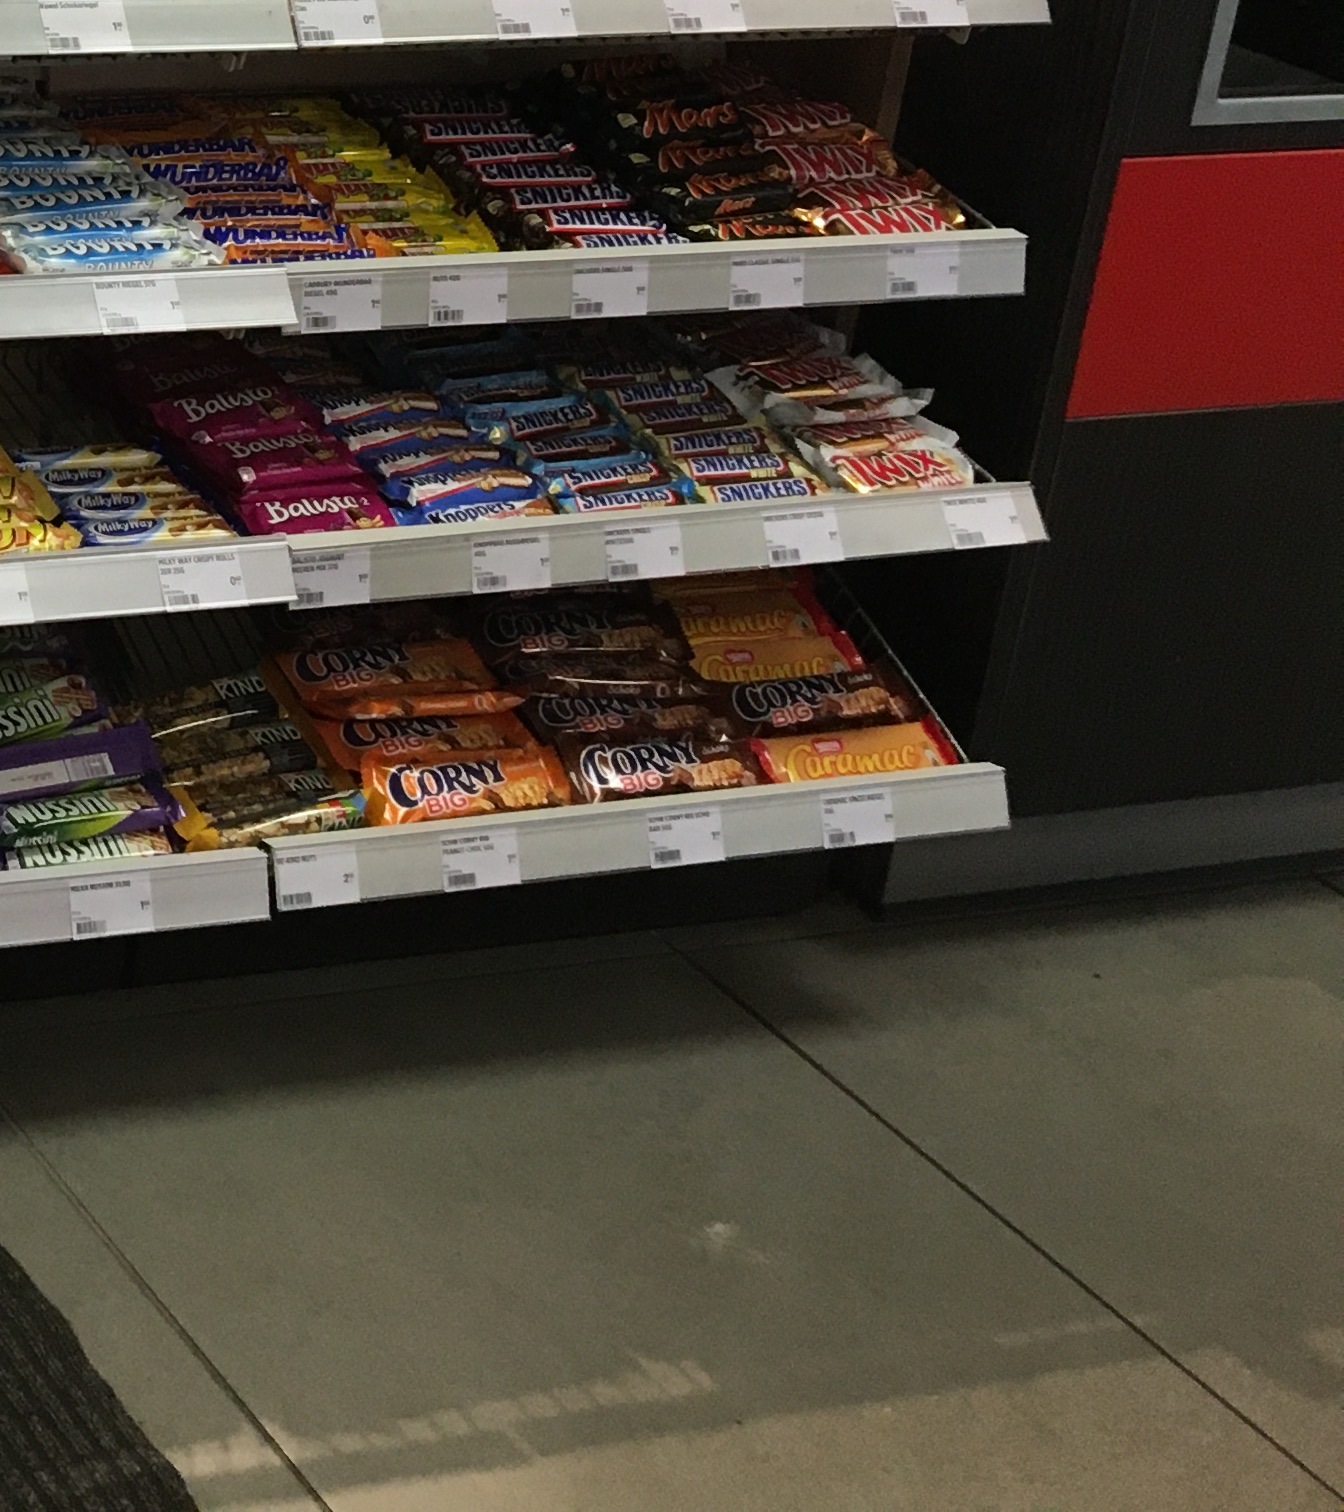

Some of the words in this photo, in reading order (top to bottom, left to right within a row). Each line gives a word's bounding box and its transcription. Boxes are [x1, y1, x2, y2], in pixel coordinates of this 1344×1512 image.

[720, 477, 808, 502] SNICKERS
[266, 496, 358, 524] Balisto
[580, 739, 697, 788] CORNY
[787, 744, 916, 779] Caramac
[387, 758, 504, 808] CORNY
[621, 769, 663, 793] BIG
[426, 792, 468, 814] BIG
